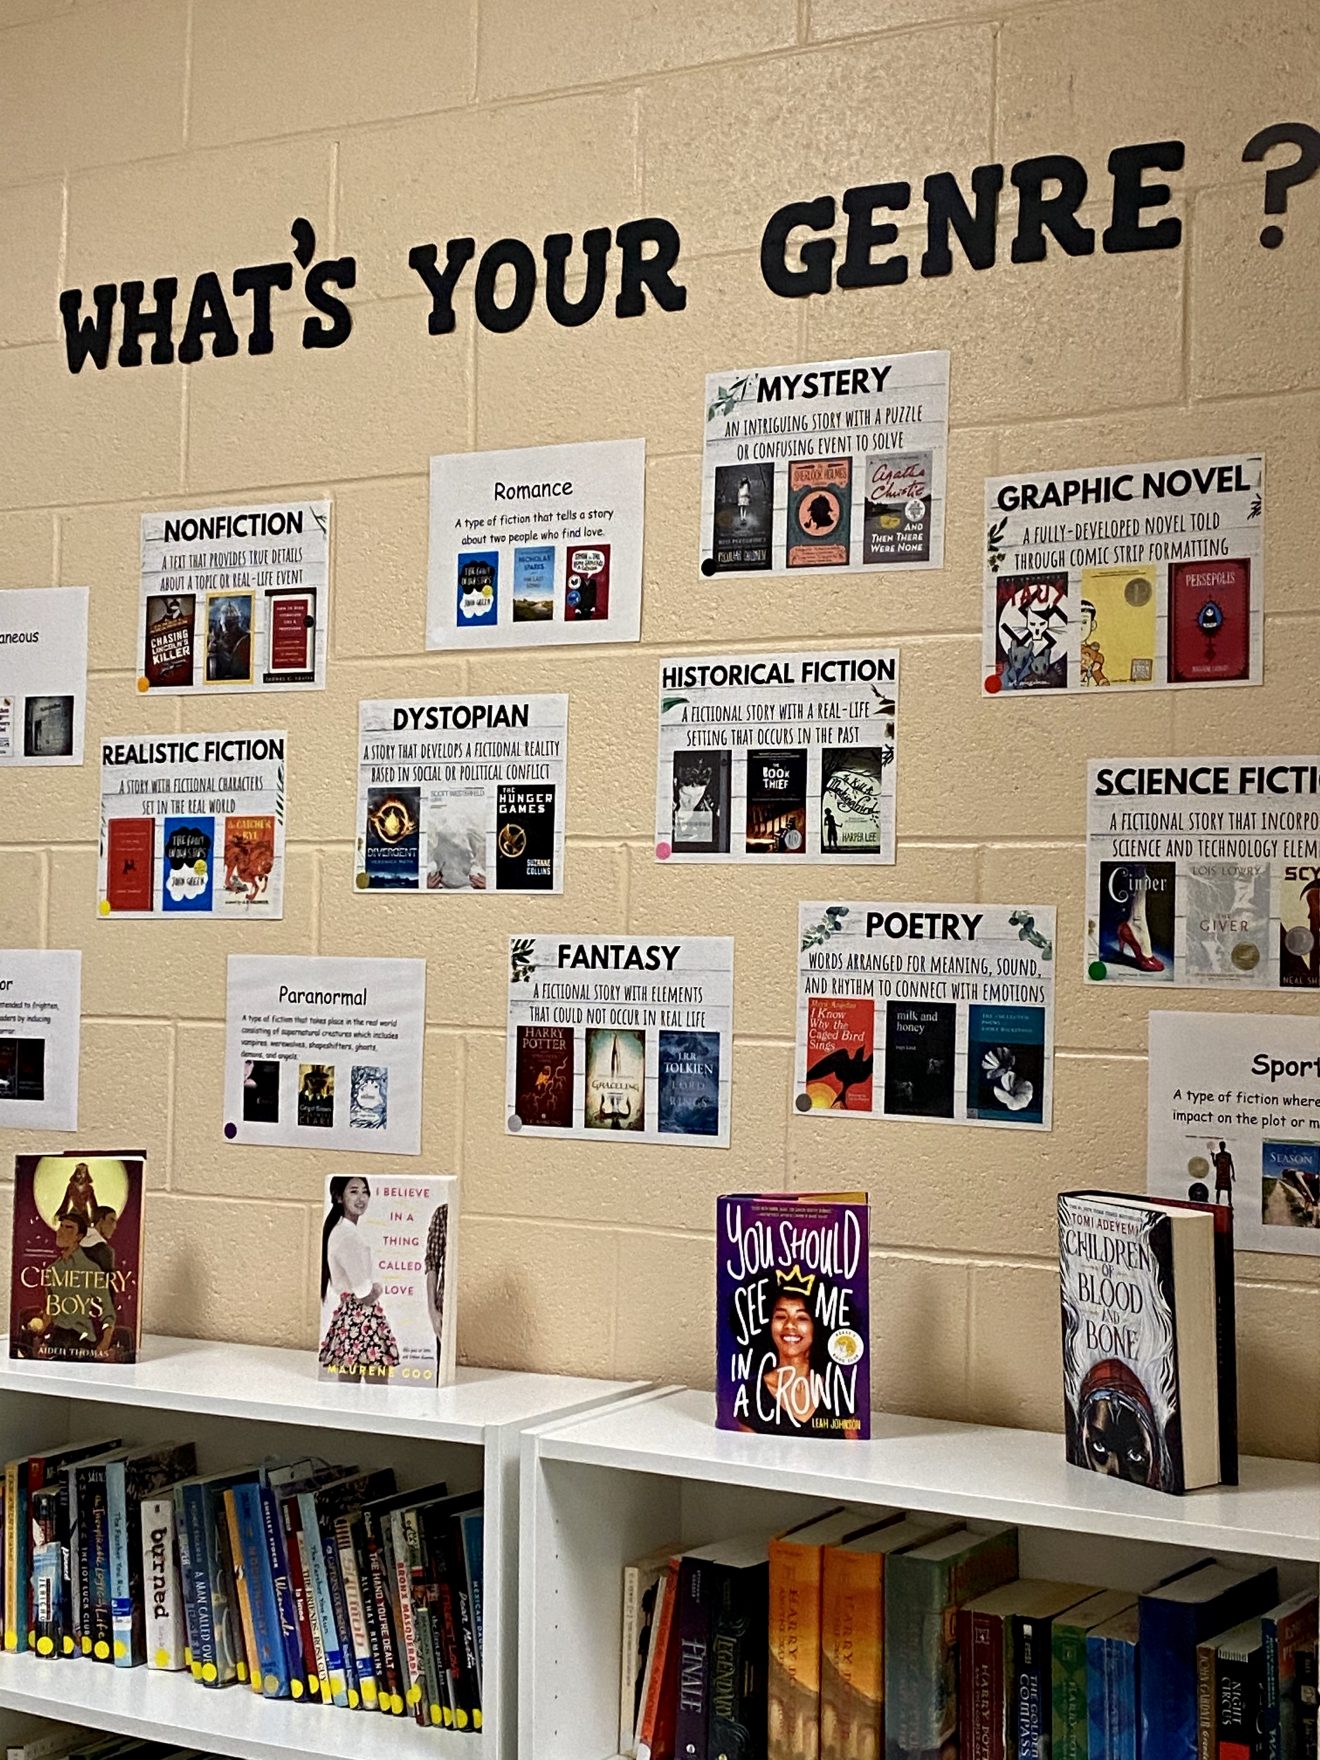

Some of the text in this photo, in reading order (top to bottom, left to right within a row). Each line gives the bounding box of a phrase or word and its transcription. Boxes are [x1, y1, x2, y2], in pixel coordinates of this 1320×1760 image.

[60, 122, 1320, 374] WHAT'S YOUR GENRE ?
[757, 365, 892, 403] MYSTERY
[725, 405, 922, 437] AN INTRIGUING STORY WITH A PUZZLE
[737, 432, 904, 460] OR CONFUSING EVENT TO SOLVE
[494, 481, 573, 500] Romance
[998, 465, 1250, 512] GRAPHIC NOVEL
[164, 511, 303, 542] NONFICTION
[455, 519, 462, 528] A
[465, 518, 484, 530] type
[487, 516, 497, 526] of
[500, 514, 530, 526] fiction
[534, 512, 553, 523] that
[557, 511, 576, 521] tells
[588, 509, 614, 521] story
[905, 523, 923, 531] AND
[1023, 512, 1220, 545] A FULLY-DEVELOPED NOVEL TOLD
[462, 526, 605, 546] about two people who find love.
[871, 533, 923, 543] THEN THERE
[871, 543, 922, 553] WERE NONE
[1015, 538, 1229, 571] THROUGH COMIC STRIP FORMATTING
[160, 569, 303, 591] ABOUT A TOPIC OR REAL-LIFE EVENT
[1185, 571, 1236, 587] PERSEPOLIS
[151, 629, 188, 648] CHASING
[153, 646, 190, 665] KILLER
[663, 659, 895, 688] HISTORICAL FICTION
[394, 704, 529, 730] DYSTOPIAN
[687, 726, 859, 746] SETTING THAT OCCURS IN THE PAST
[103, 739, 284, 765] REALISTIC FICTION
[371, 763, 550, 782] BASED IN SOCIAL OR POLITICAL CONFLICT
[763, 766, 790, 778] BOOK
[763, 778, 789, 789] THIEF
[1095, 766, 1320, 796] SCIENCE FICTI
[142, 799, 235, 815] SET IN THE REAL WORLD
[499, 794, 552, 803] HUNGER
[499, 805, 545, 813] GAMES
[1113, 839, 1317, 858] SCIENCE AND TECHNOLOGY ELEM
[1108, 866, 1167, 903] Cinder
[866, 912, 984, 941] POETRY
[558, 944, 681, 971] FANTASY
[809, 952, 1042, 978] WORDS ARRANGED FOR MEANING, SOUND,
[279, 986, 367, 1006] Paranormal
[533, 983, 703, 1003] A FICTIONAL STORY WITH ELEMENTS
[897, 1011, 938, 1022] milk and
[897, 1021, 925, 1035] honey
[523, 1038, 566, 1049] POTTER
[525, 1027, 564, 1038] HARRY
[664, 1062, 713, 1075] TOLKIEN
[1251, 1054, 1320, 1082] Sport
[1173, 1089, 1320, 1108] A type of fiction where
[384, 1188, 430, 1198] BELIEVE
[390, 1212, 414, 1222] IN A
[1070, 1212, 1094, 1230] TOMI
[383, 1236, 419, 1246] THING
[727, 1203, 861, 1281] YOU SHOULD
[1065, 1228, 1153, 1273] CHILDREN
[378, 1260, 422, 1271] CALLED
[1101, 1262, 1113, 1279] OF
[20, 1266, 132, 1293] CEMETERY
[384, 1286, 414, 1296] LOVE
[1078, 1272, 1143, 1314] BLOOD
[46, 1294, 103, 1318] BOYS
[734, 1278, 853, 1346] SEE ME
[1102, 1308, 1120, 1325] AND
[1086, 1319, 1139, 1362] BONE
[731, 1347, 857, 1428] IN CROWN
[733, 1383, 750, 1418] A
[151, 1527, 169, 1620] burned
[361, 1576, 382, 1676] ALL THAT REMAINS
[396, 1562, 418, 1676] BRONX MASQUERADE
[680, 1638, 706, 1713] FINALE
[1030, 1676, 1039, 1700] THE
[1221, 1677, 1232, 1726] CIRCUS
[1231, 1682, 1242, 1725] NIGHT
[1020, 1674, 1031, 1757] COMPASS
